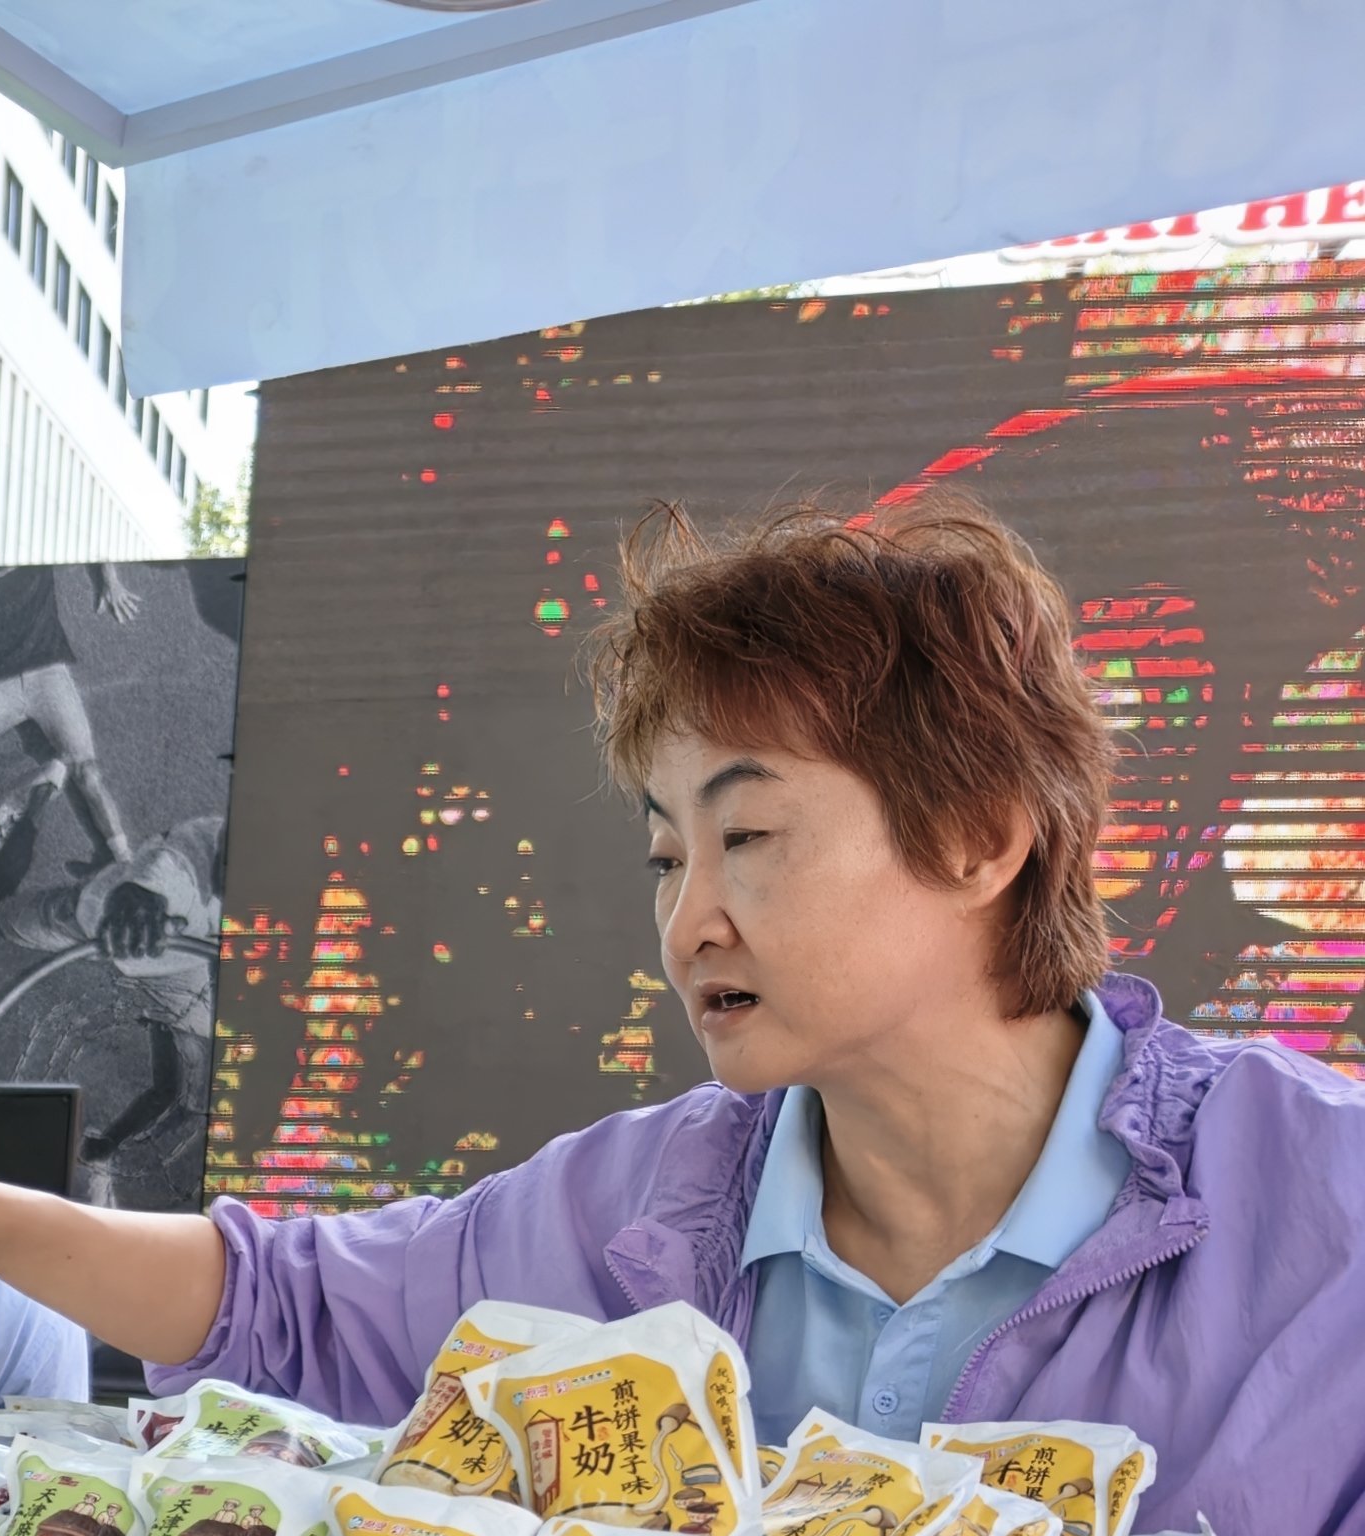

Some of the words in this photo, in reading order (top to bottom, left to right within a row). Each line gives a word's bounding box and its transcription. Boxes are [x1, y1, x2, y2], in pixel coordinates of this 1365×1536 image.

[568, 1405, 617, 1478] 牛奶
[611, 1378, 653, 1495] 煎饼果子味
